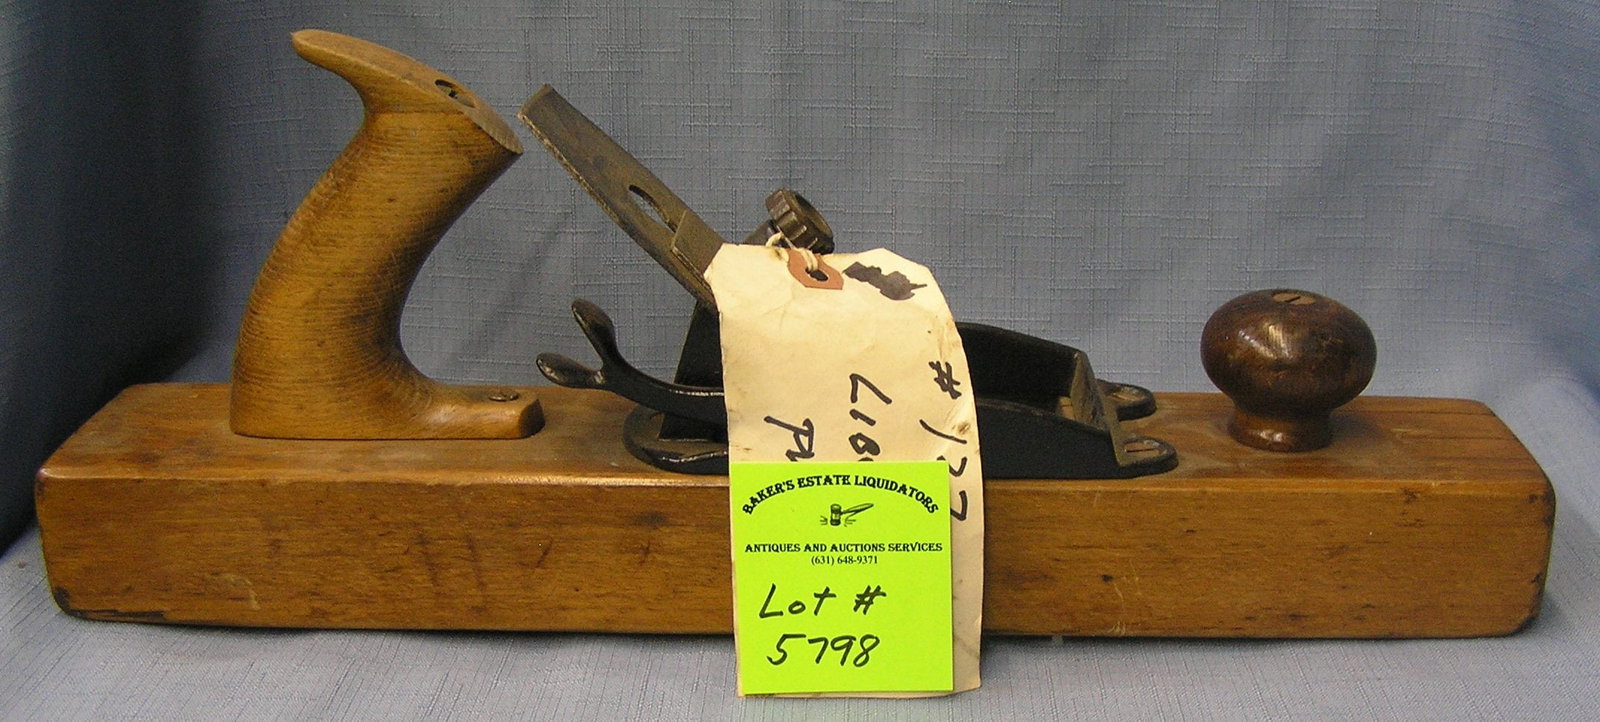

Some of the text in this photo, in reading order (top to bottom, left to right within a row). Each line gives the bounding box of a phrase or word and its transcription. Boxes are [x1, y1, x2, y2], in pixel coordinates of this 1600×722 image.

[848, 373, 893, 461] LIB
[742, 474, 939, 515] BAKER'S ESTATE LIQUIDATORS
[744, 541, 943, 553] ANTIQUES AND AUCTIONS SERVICES
[811, 555, 878, 566] (631) 648-9371
[758, 583, 887, 619] Lot #
[766, 633, 881, 668] 5798
